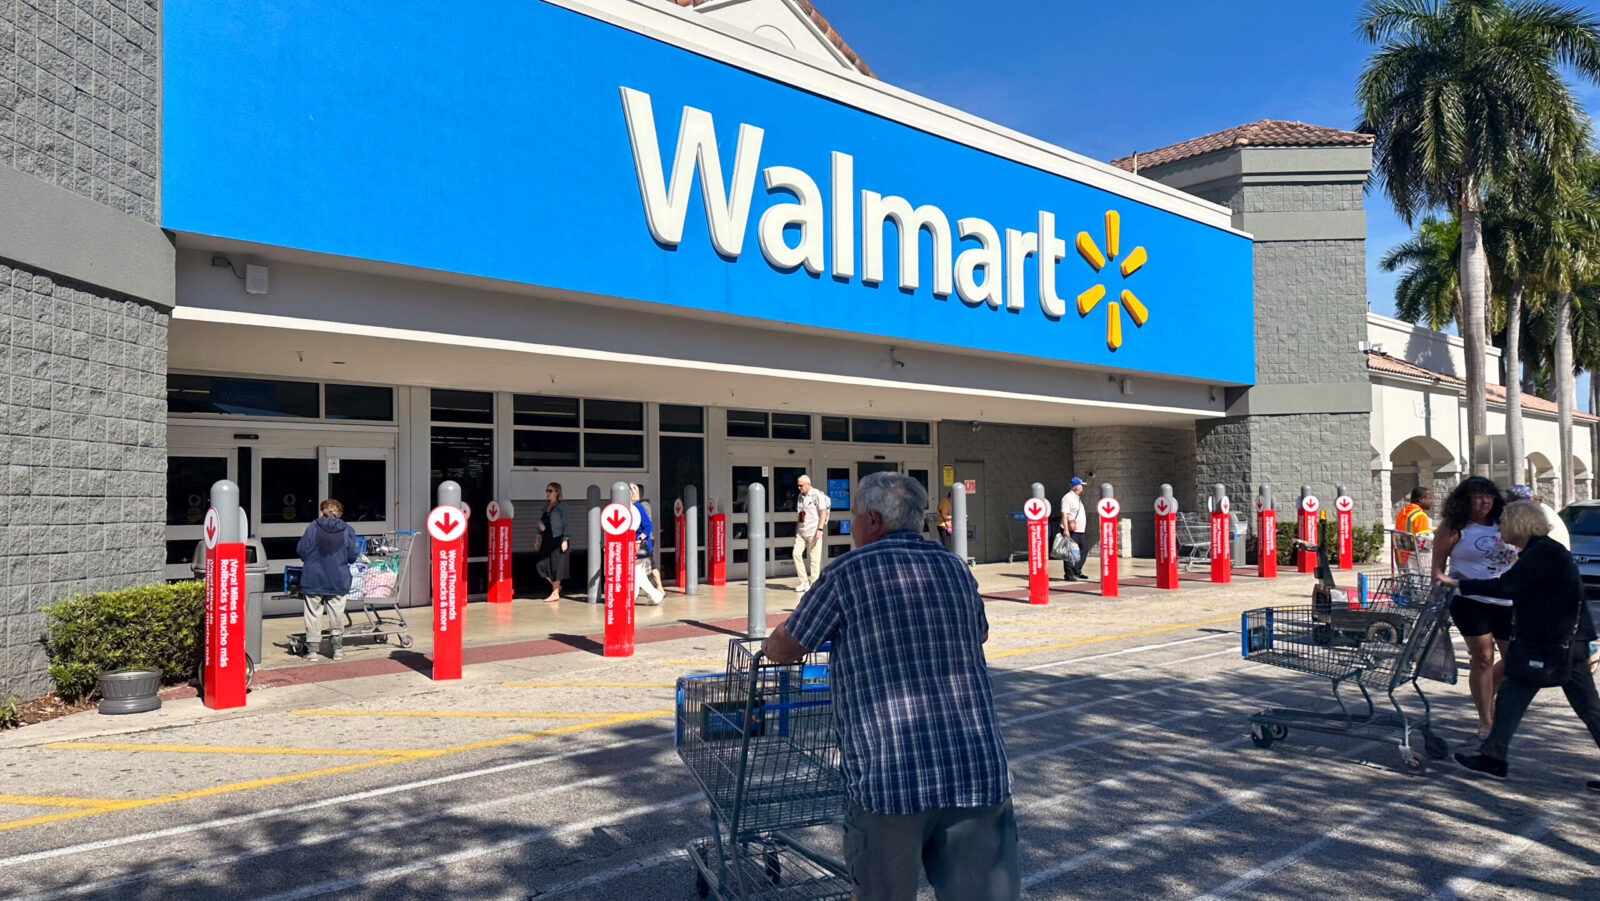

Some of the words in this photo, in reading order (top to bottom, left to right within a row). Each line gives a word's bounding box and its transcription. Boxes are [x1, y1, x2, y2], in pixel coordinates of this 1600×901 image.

[619, 86, 1066, 318] Walmart
[440, 550, 448, 559] of
[449, 549, 457, 572] Wow!
[220, 558, 229, 604] Rollbacks
[440, 560, 448, 600] Rollbacks
[230, 586, 238, 610] Miles
[449, 574, 457, 620] Thousands
[220, 613, 229, 646] mucho
[230, 612, 238, 624] de
[440, 609, 448, 632] more
